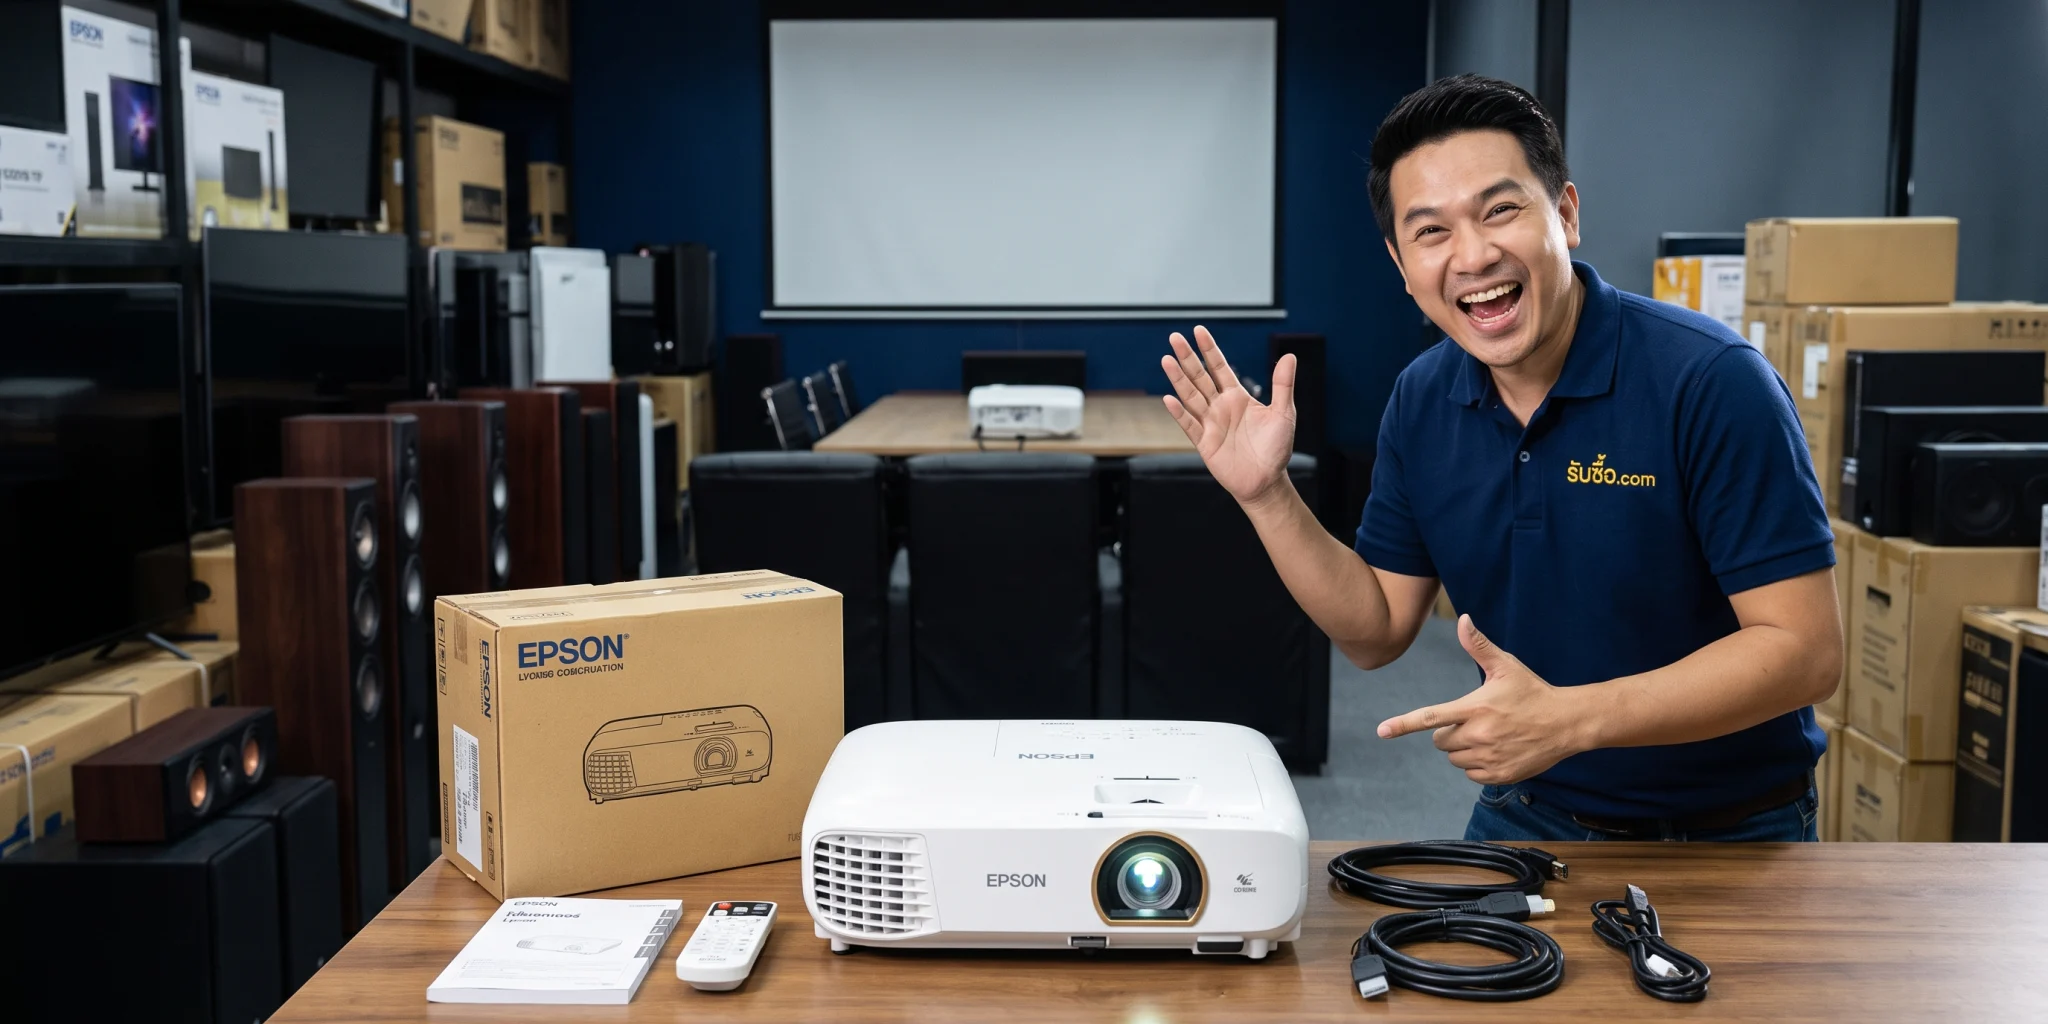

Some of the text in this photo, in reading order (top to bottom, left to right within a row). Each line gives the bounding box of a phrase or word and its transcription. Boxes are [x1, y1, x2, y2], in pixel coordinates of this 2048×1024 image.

[1567, 453, 1656, 487] รับซื้อ.com
[481, 640, 491, 719] EPSON
[987, 873, 1046, 888] EPSON
